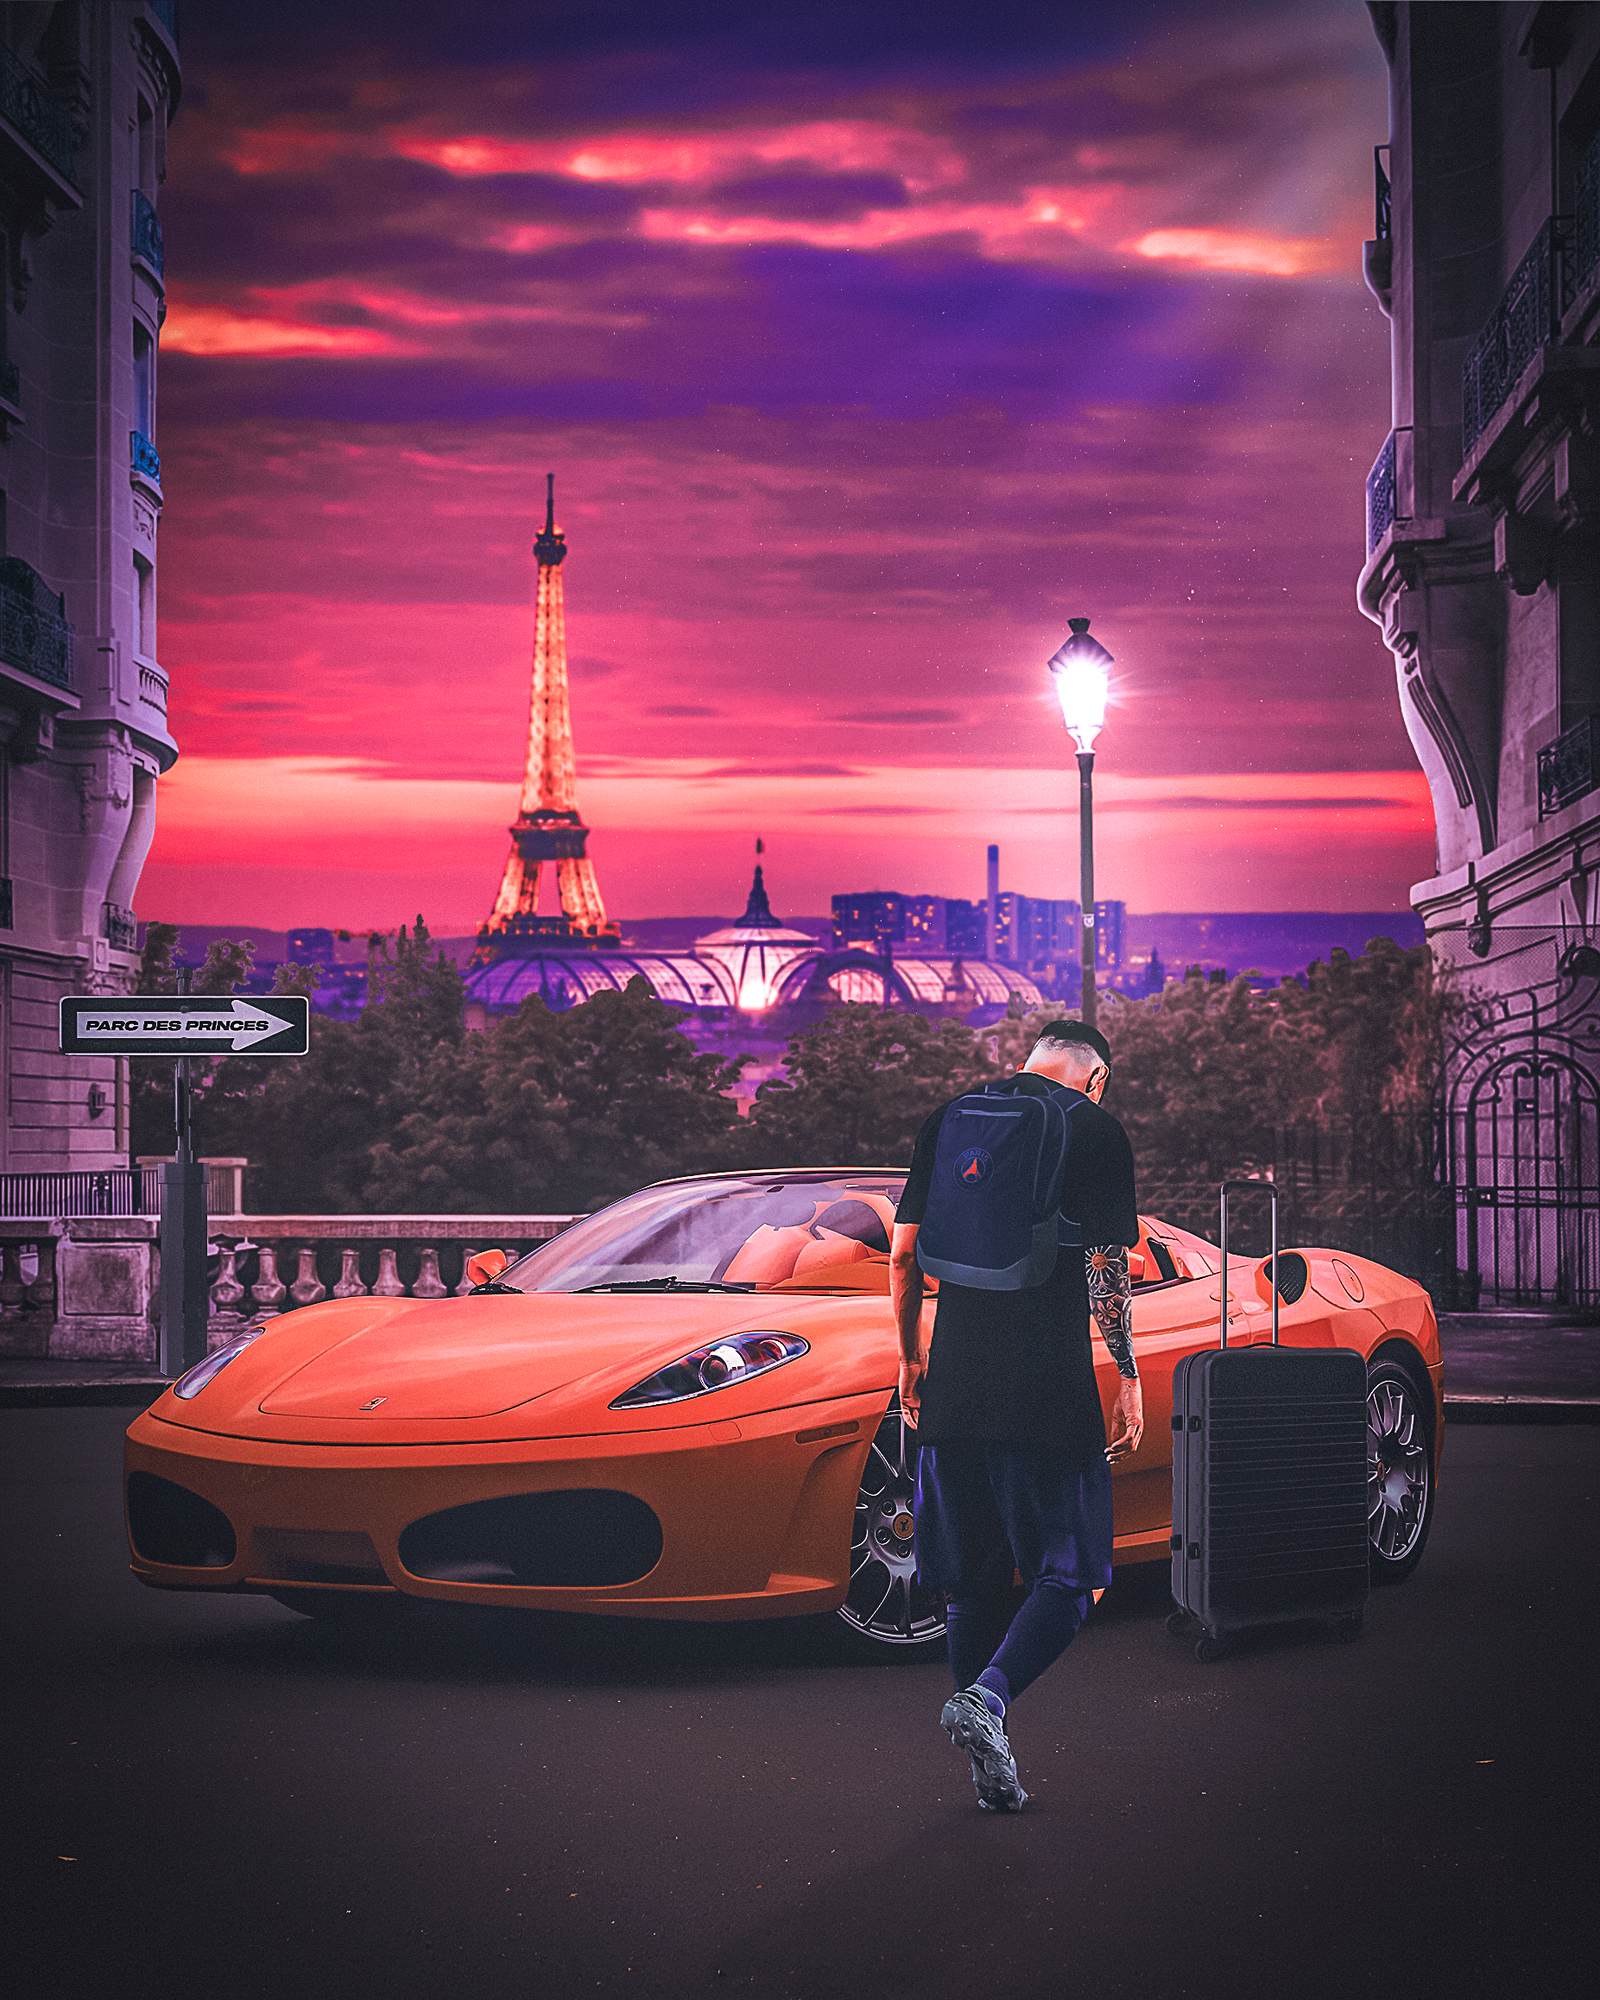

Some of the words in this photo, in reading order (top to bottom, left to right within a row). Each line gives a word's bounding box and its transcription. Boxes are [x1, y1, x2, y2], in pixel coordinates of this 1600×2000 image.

[86, 1020, 138, 1031] PARC
[142, 1020, 182, 1031] DES
[185, 1020, 269, 1031] PRINCES
[963, 1149, 990, 1162] PARIS
